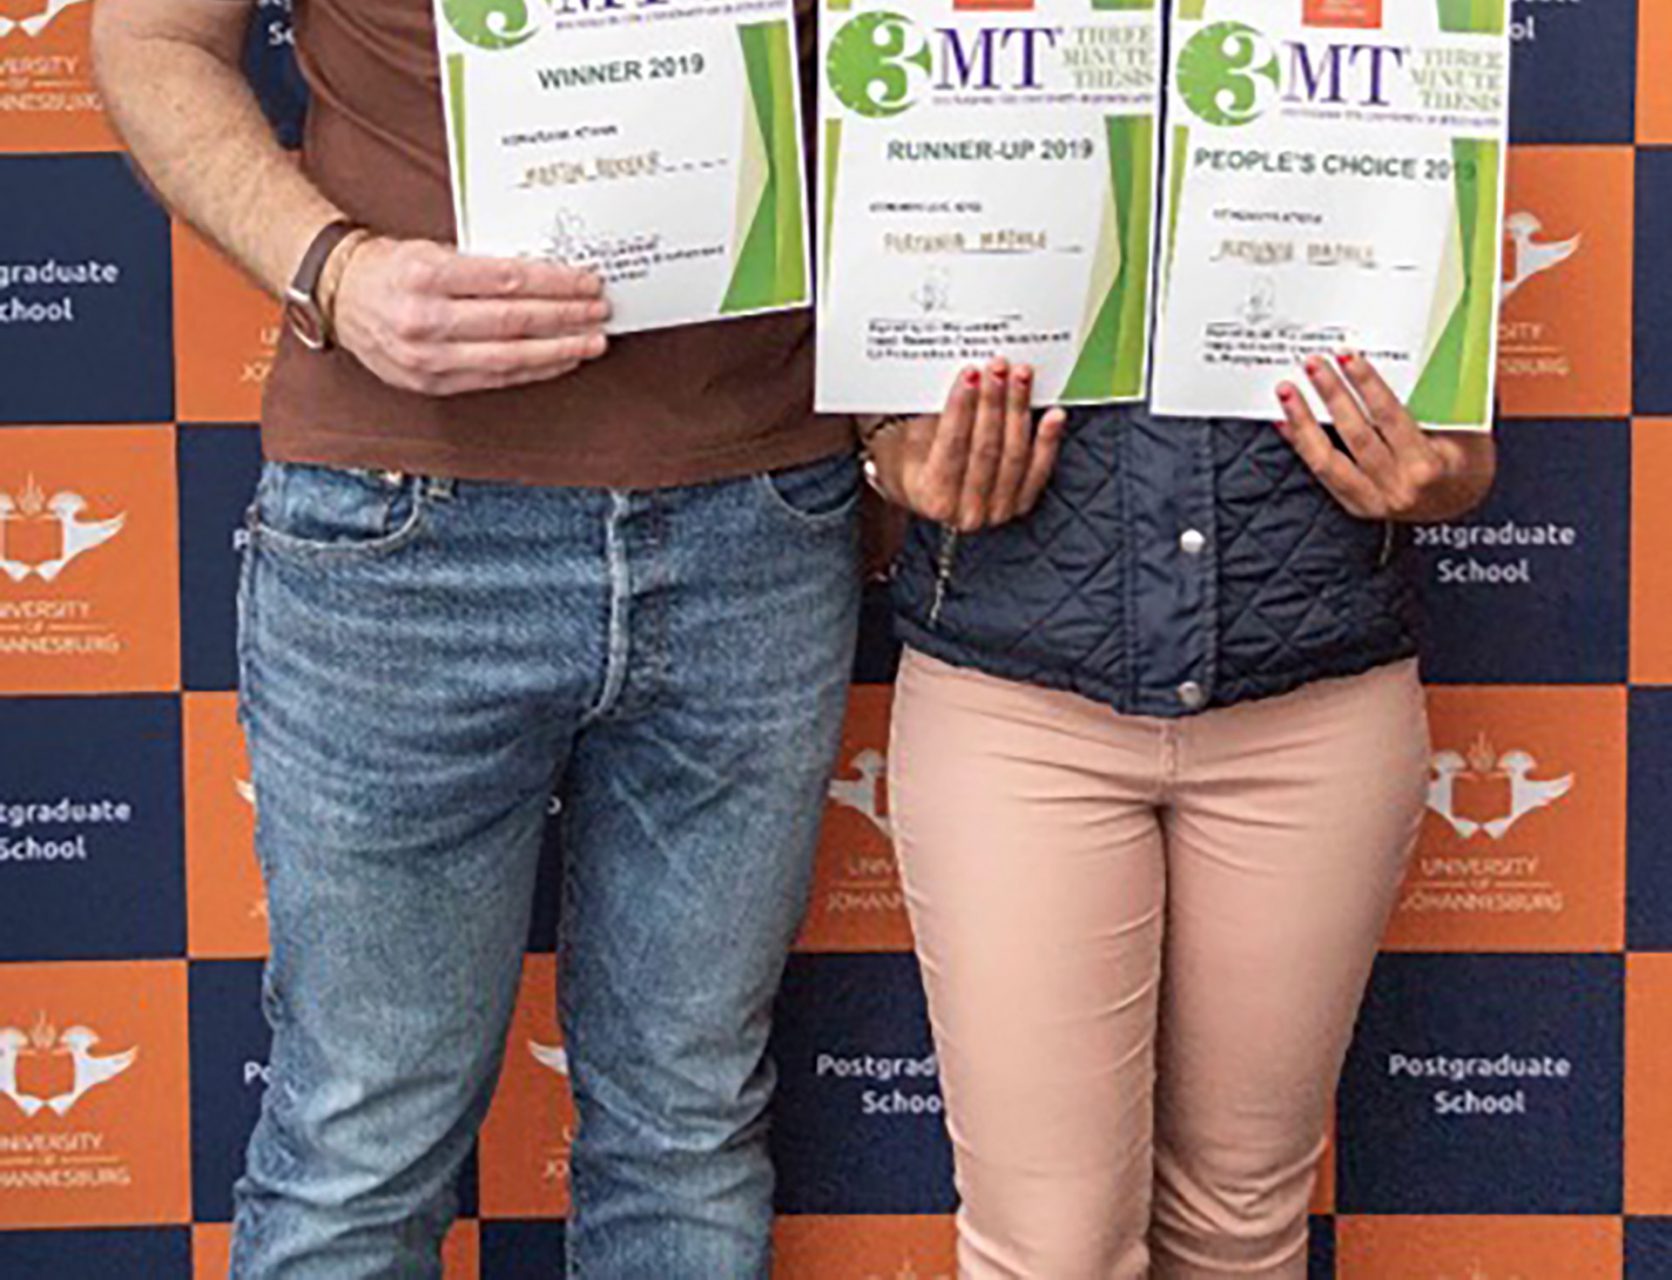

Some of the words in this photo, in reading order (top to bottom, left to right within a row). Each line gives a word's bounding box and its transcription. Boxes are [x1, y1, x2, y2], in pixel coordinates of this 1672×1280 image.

[538, 62, 642, 90] WINNER
[649, 53, 705, 80] 2019
[887, 139, 1036, 162] RUNNER-UP
[1041, 138, 1094, 160] 2019
[1194, 147, 1316, 174] PEOPLE'S
[1322, 153, 1417, 179] CHOICE
[1413, 521, 1576, 549] ostgraduate
[1437, 558, 1530, 583] School
[817, 1055, 937, 1080] Postgrad
[1388, 1054, 1570, 1081] Postgraduate
[862, 1090, 942, 1114] Schoo
[1434, 1088, 1524, 1114] School
